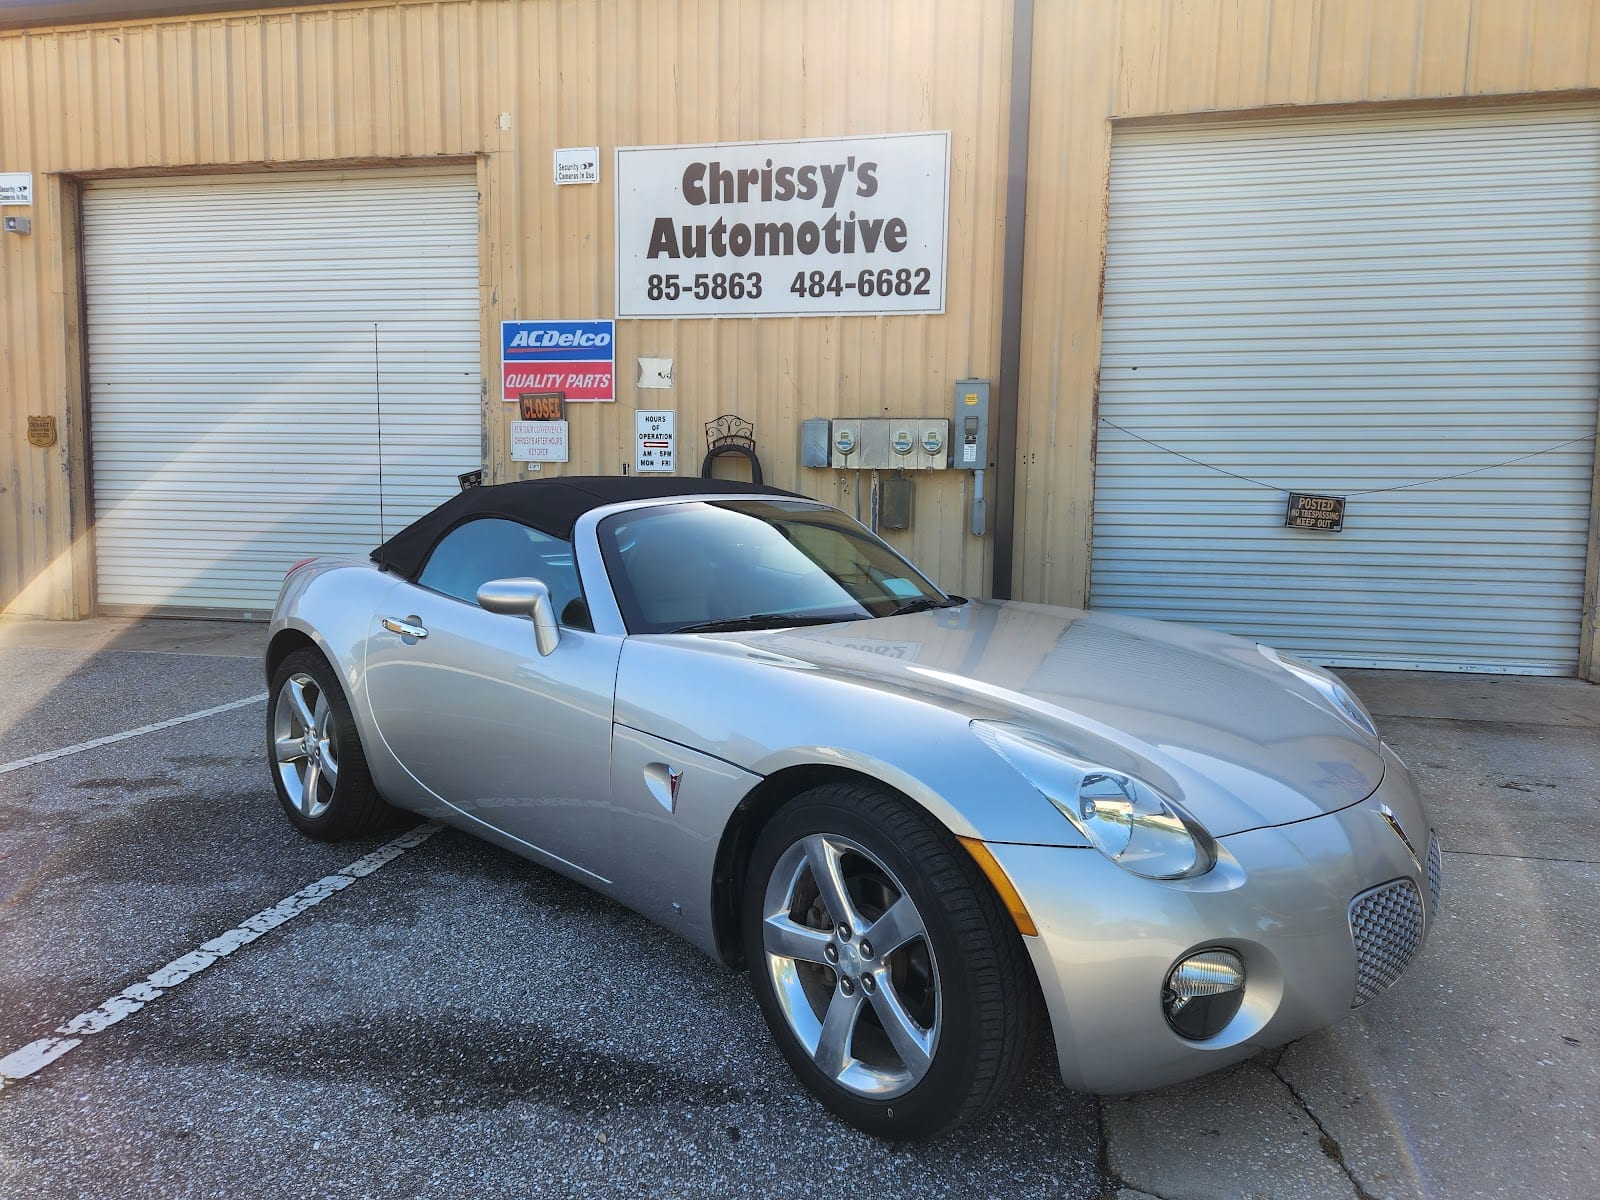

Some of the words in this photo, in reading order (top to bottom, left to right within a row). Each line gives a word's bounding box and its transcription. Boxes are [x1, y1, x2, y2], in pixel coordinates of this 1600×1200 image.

[681, 155, 879, 209] Chrissy's
[646, 210, 908, 259] Automotive
[647, 272, 763, 301] 85-5863
[790, 267, 931, 298] 484-6682
[509, 329, 611, 347] ACDelco
[505, 374, 565, 388] QUALITY
[565, 373, 611, 388] PARTS
[1298, 498, 1334, 511] POSTED
[1291, 508, 1300, 516] NO
[1301, 509, 1340, 520] TRESPASSING
[1296, 517, 1315, 526] KEEP
[1317, 519, 1333, 528] OUT
